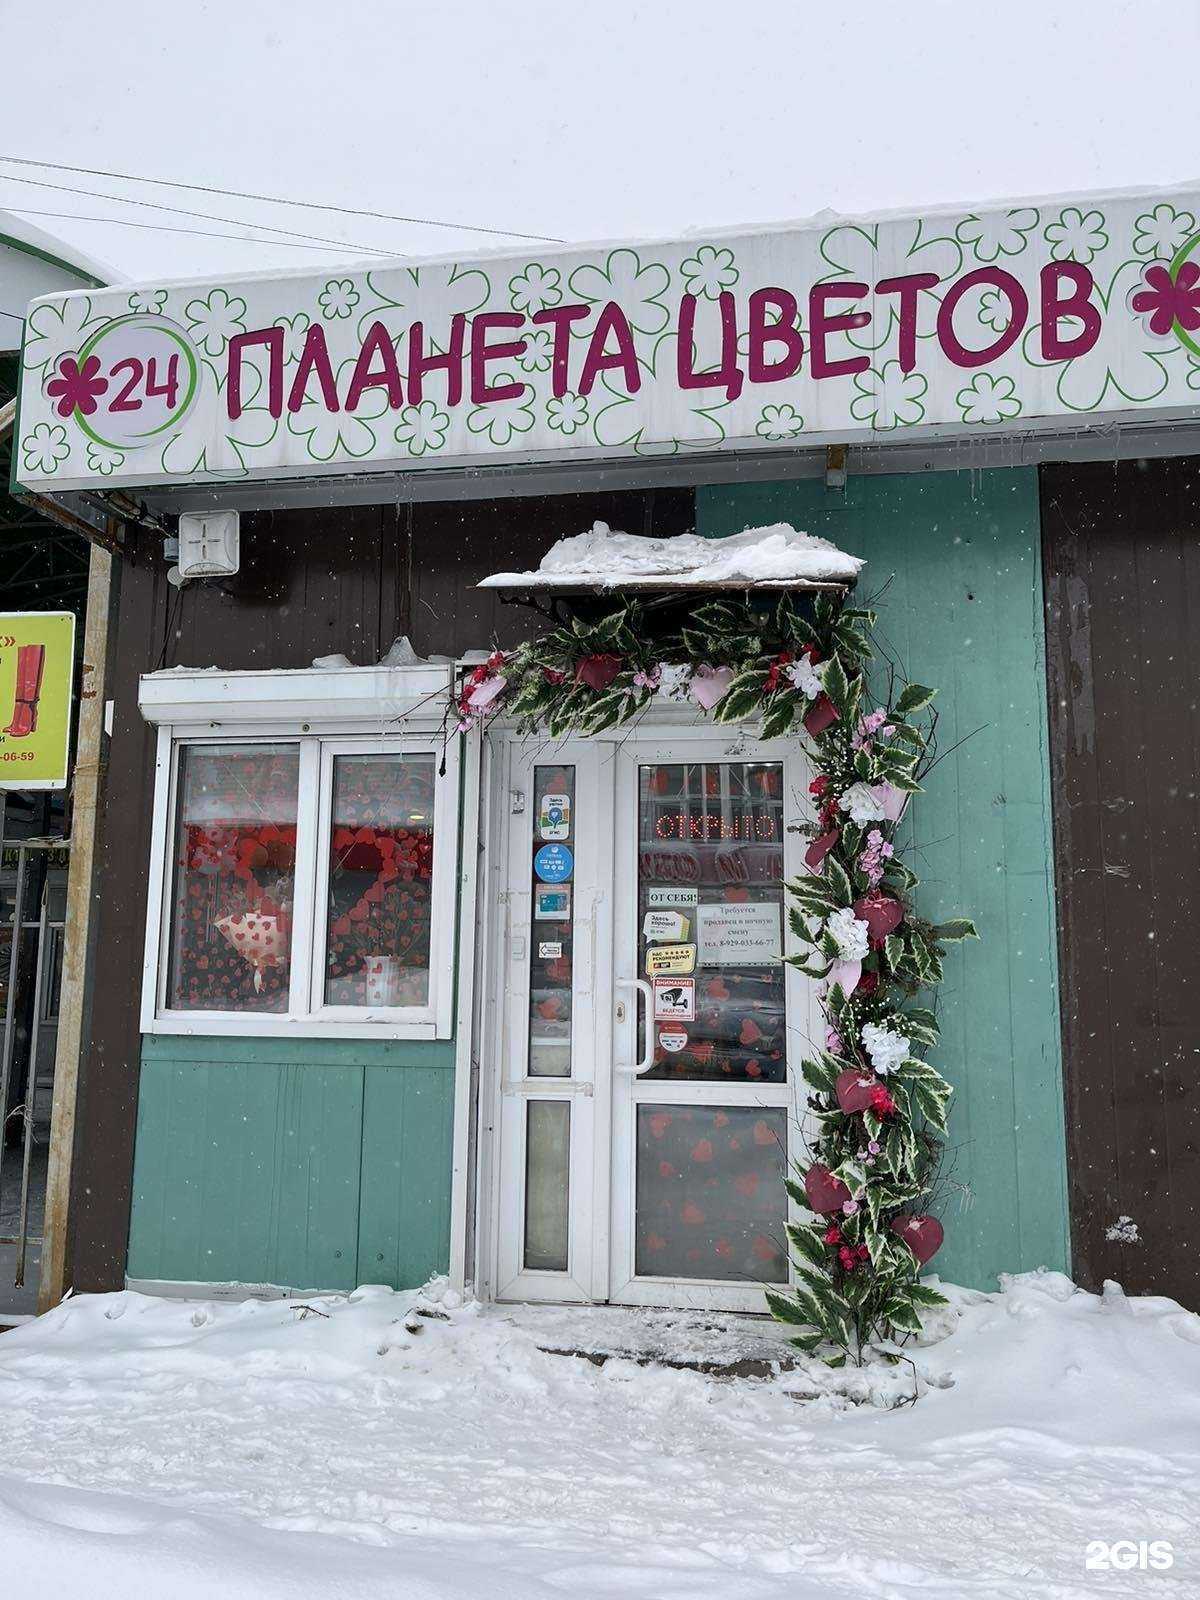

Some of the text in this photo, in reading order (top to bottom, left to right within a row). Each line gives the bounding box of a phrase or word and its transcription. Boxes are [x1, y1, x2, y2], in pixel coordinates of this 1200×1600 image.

[228, 262, 1102, 419] ПЛАНЕТА ЦВЕТОВ
[107, 355, 180, 413] 24
[655, 814, 776, 840] ОТКРЫТО
[650, 893, 697, 902] ОТ СЕБЯ!
[720, 906, 756, 915] Требуется
